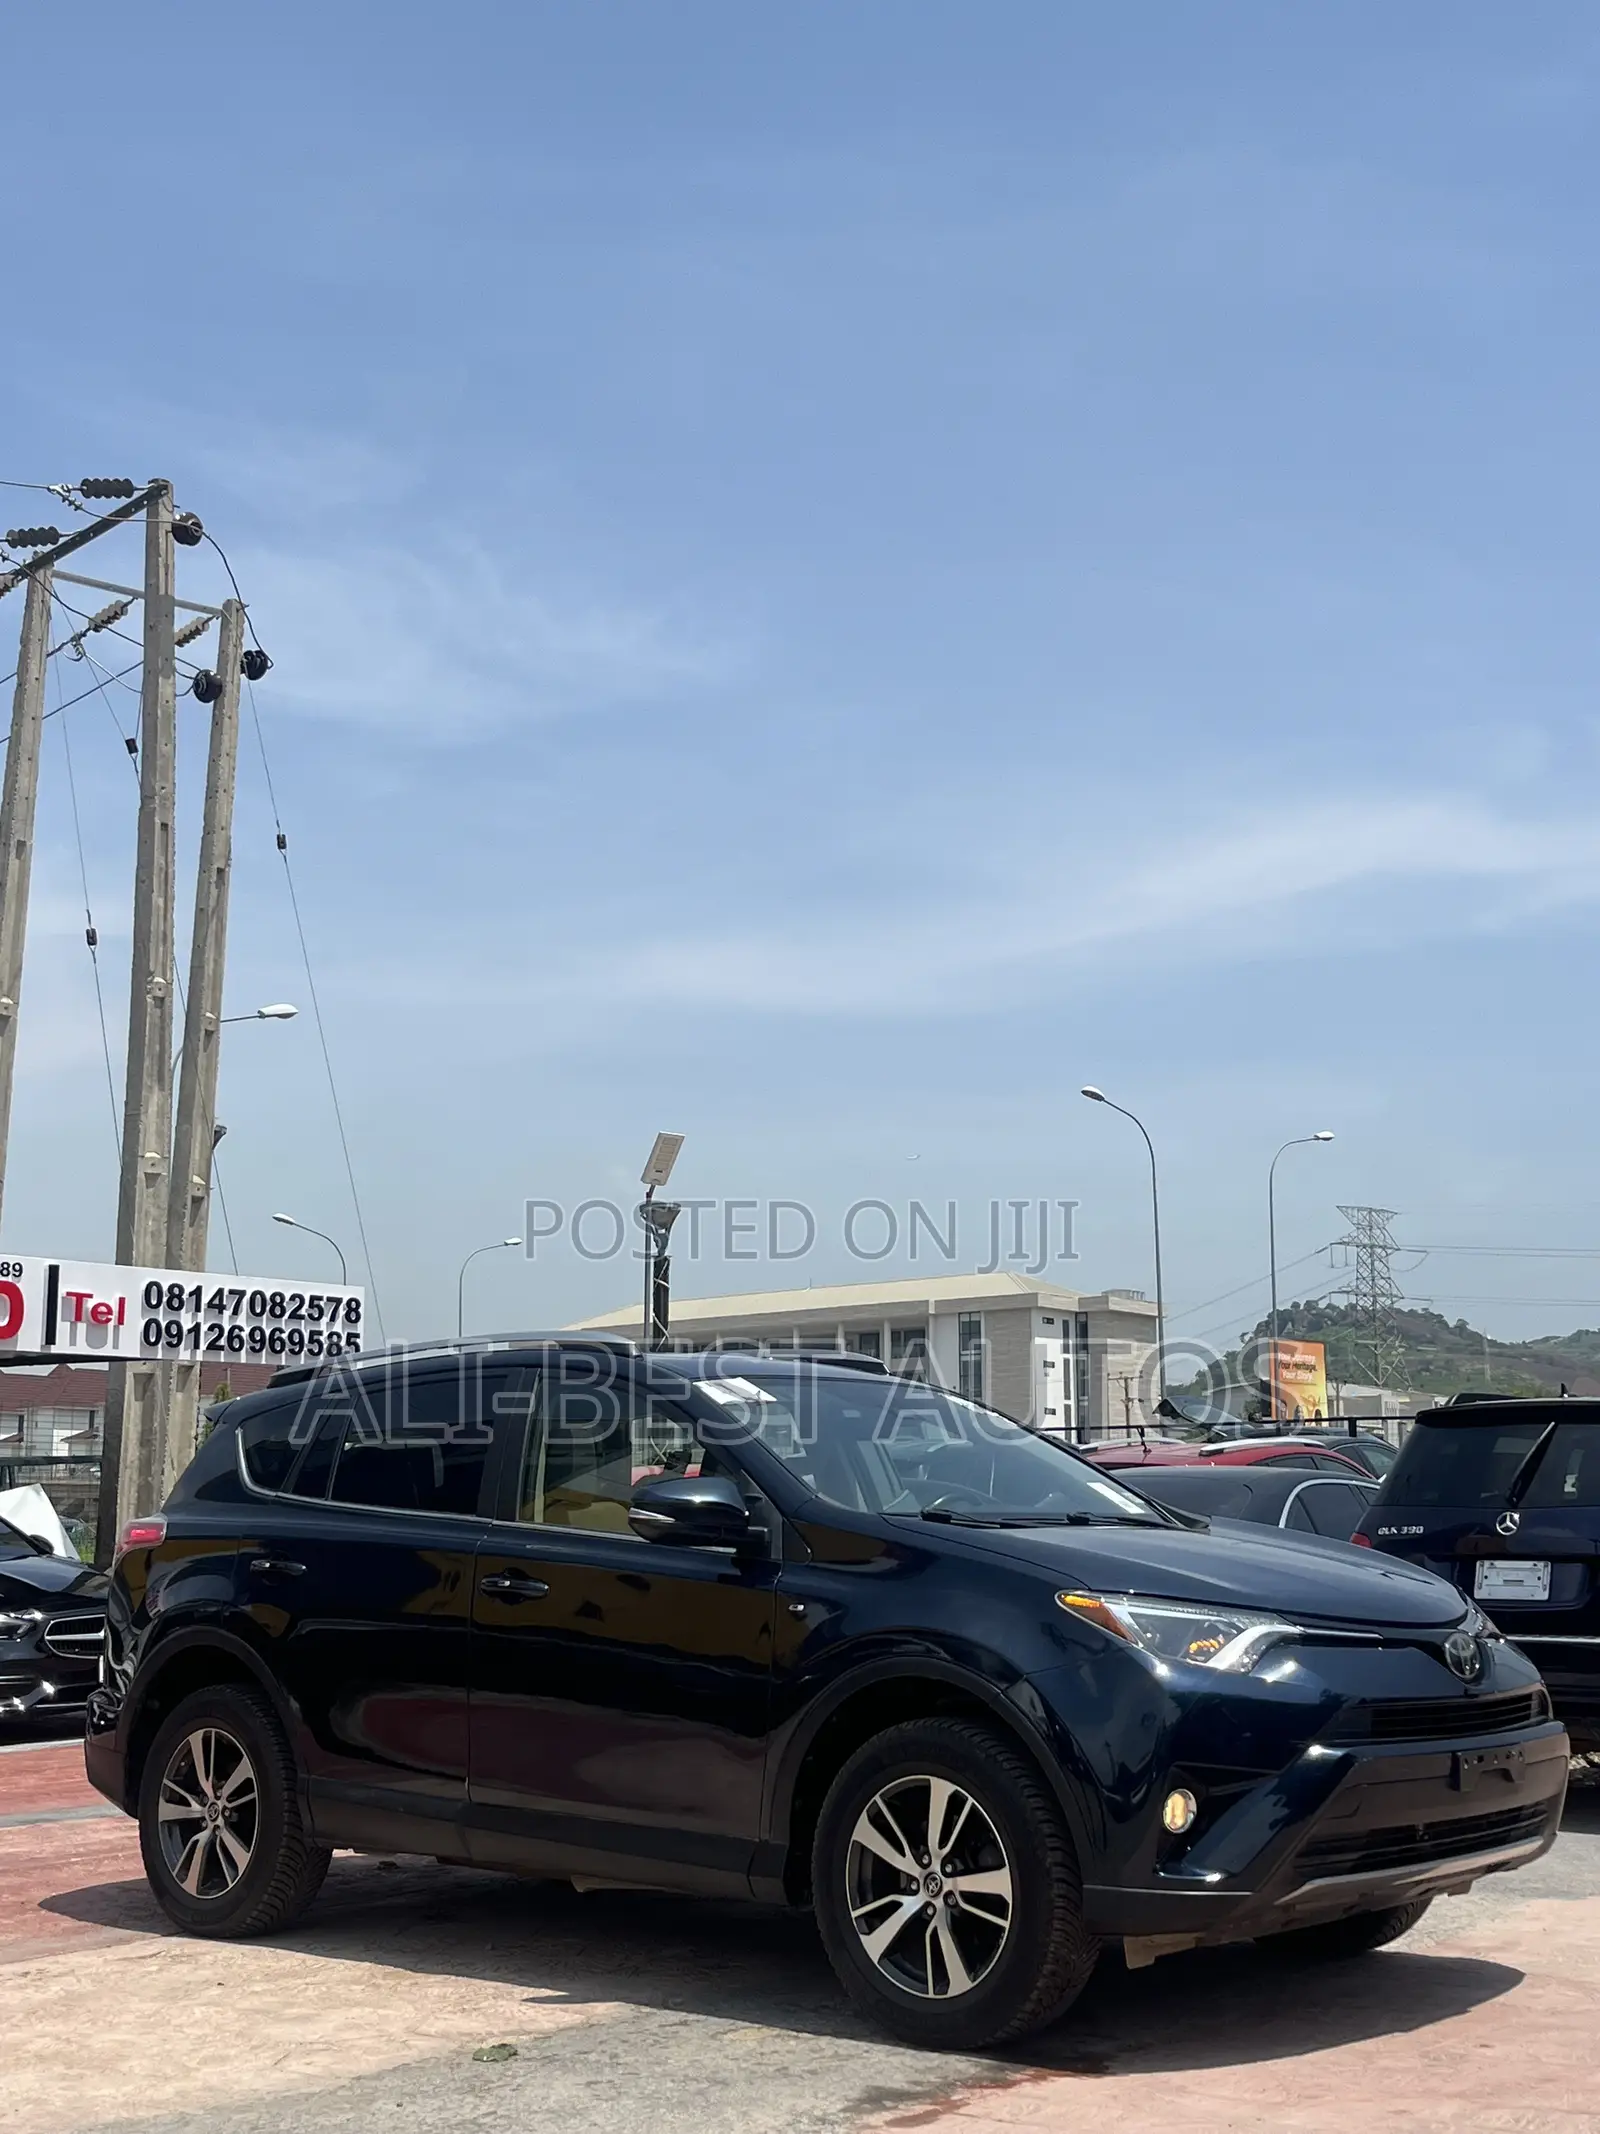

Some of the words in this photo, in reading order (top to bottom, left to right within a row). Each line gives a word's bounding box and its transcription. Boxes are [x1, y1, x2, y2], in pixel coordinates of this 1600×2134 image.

[65, 1291, 126, 1326] Tel
[144, 1280, 361, 1324] 08147082578
[142, 1317, 361, 1358] 09126969585
[1278, 1360, 1291, 1370] Your
[1282, 1370, 1296, 1379] Your
